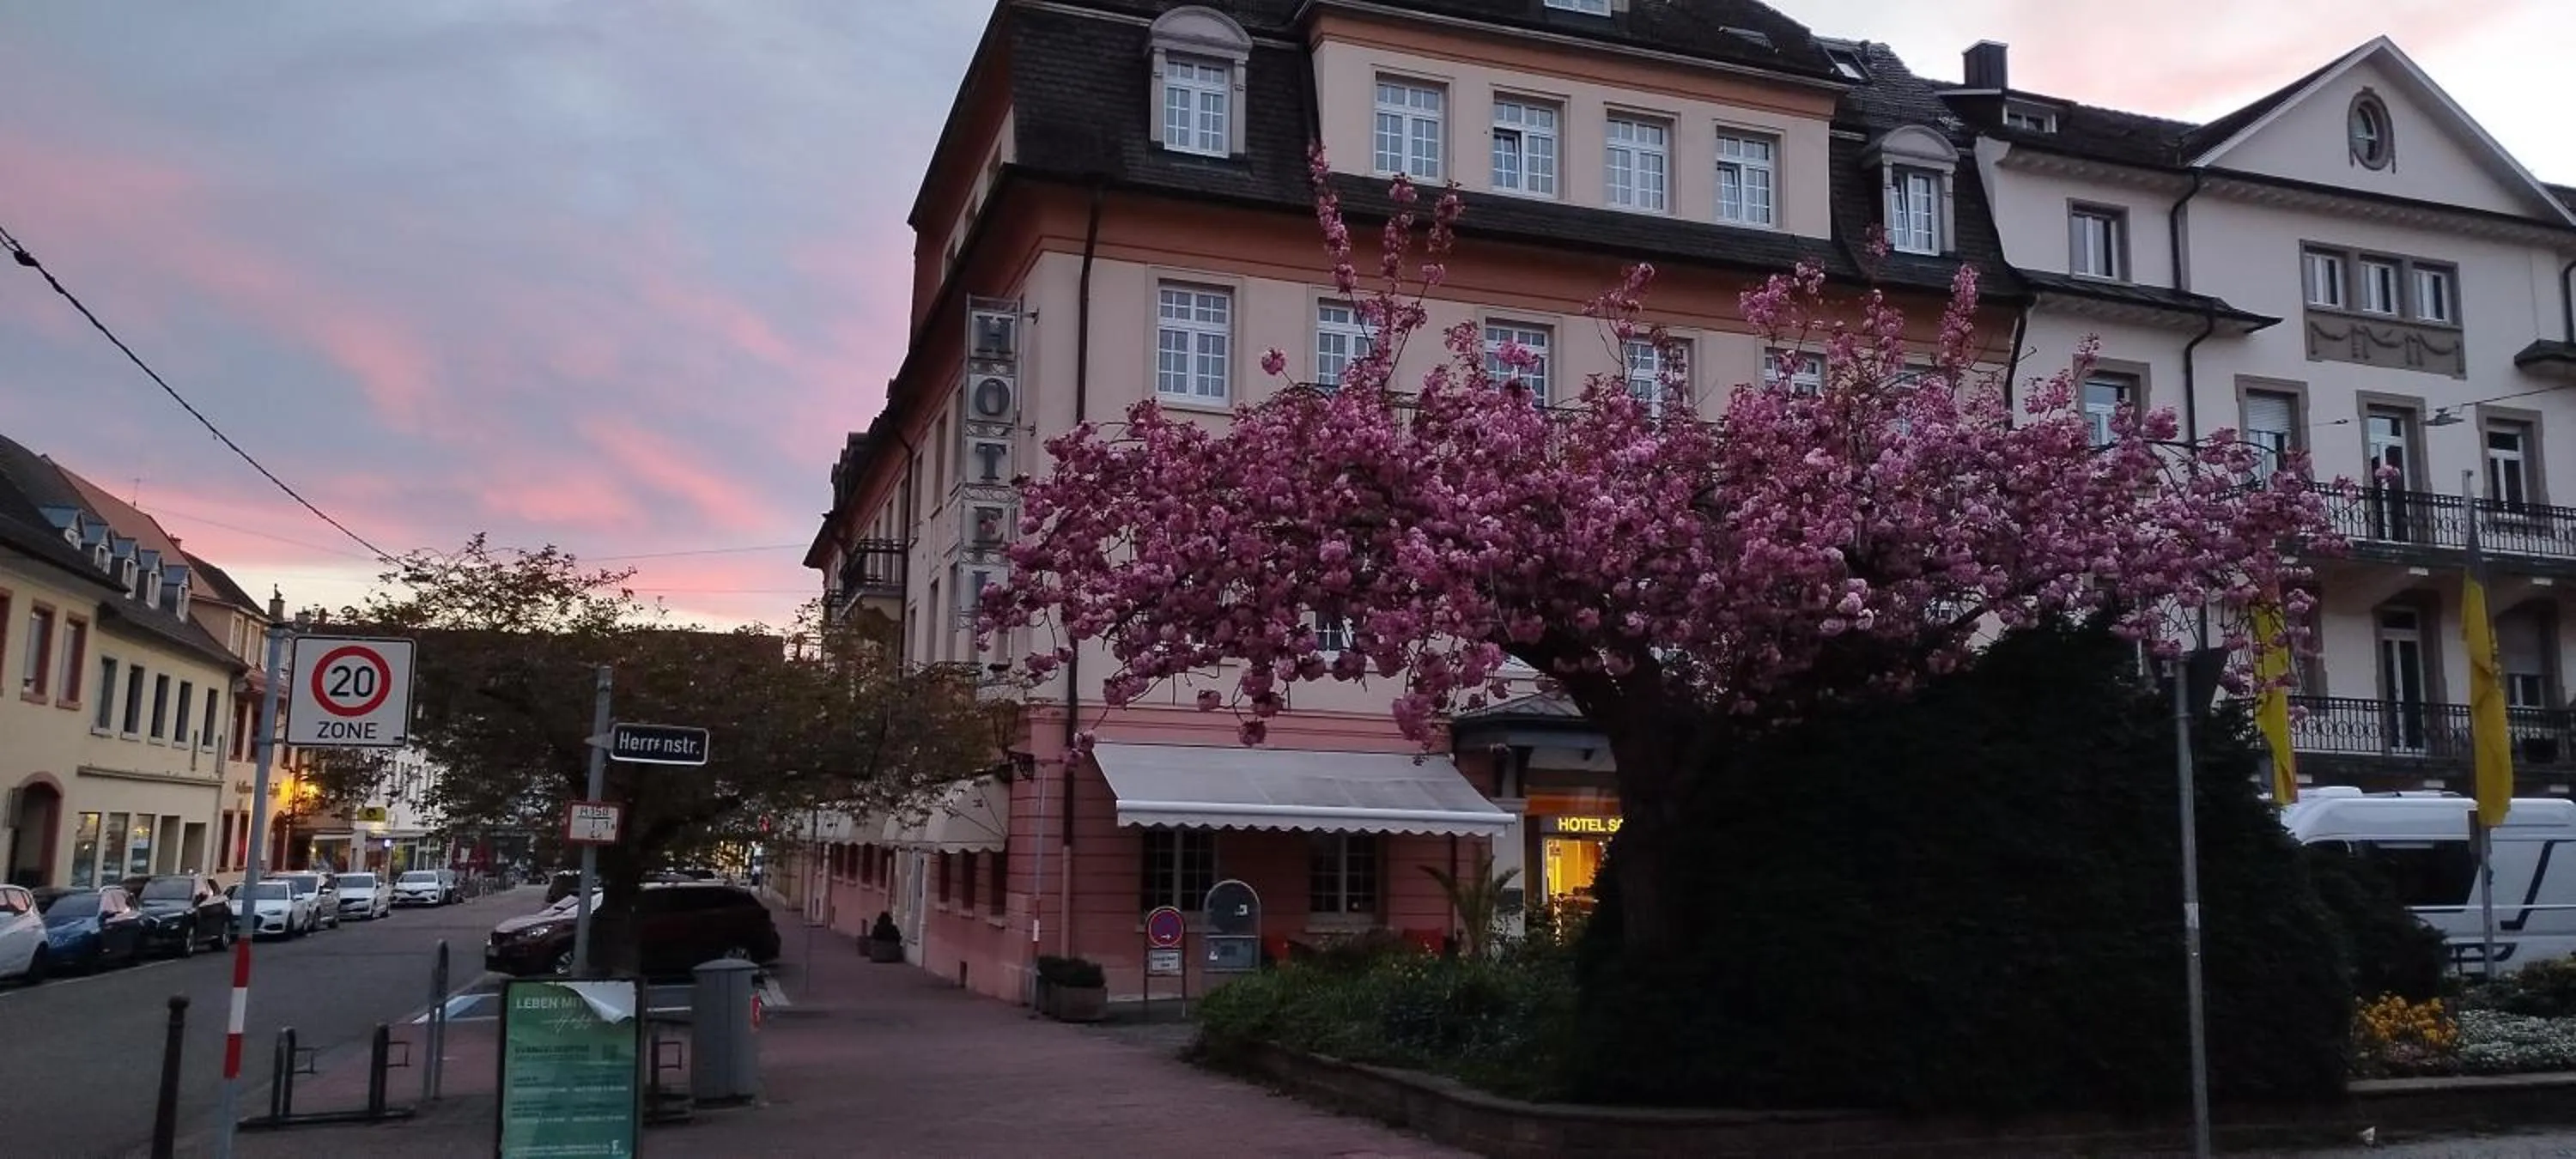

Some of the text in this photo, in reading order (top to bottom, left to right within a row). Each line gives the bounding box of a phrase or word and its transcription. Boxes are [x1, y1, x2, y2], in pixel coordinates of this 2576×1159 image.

[329, 665, 375, 697] 20
[317, 720, 378, 739] ZONE
[1558, 816, 1606, 832] HOTEL
[516, 997, 557, 1009] LEBEN
